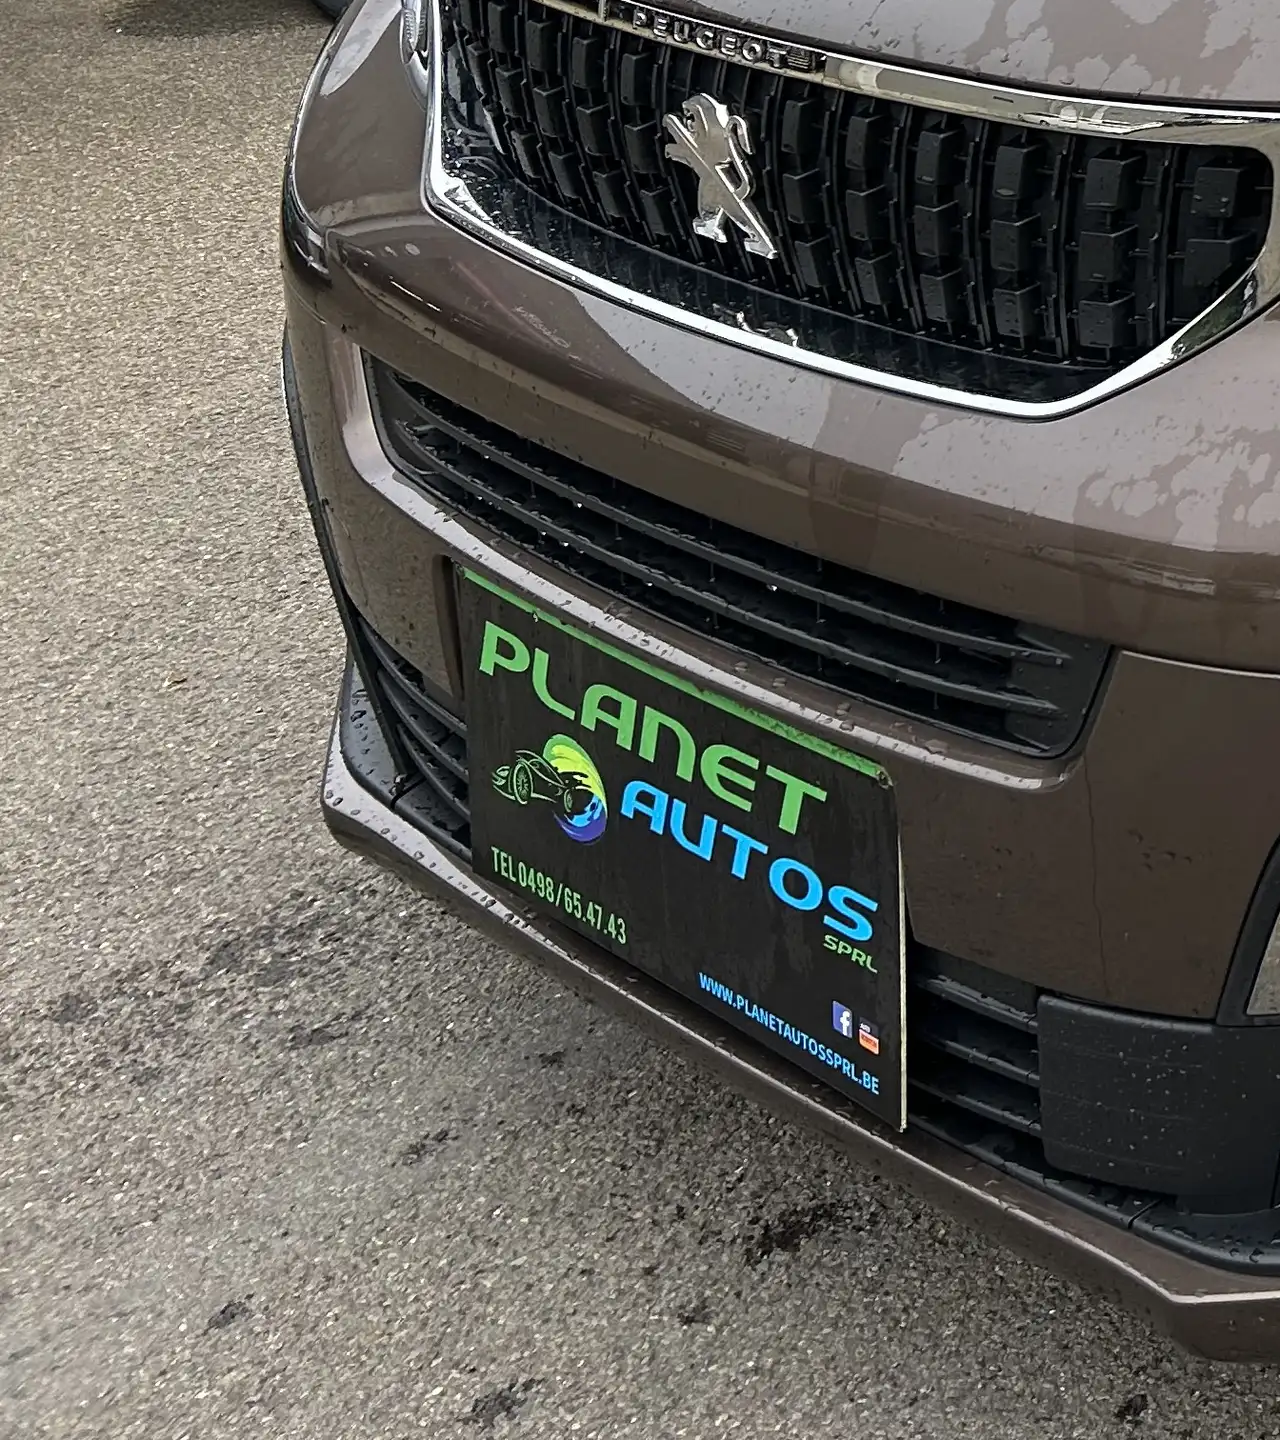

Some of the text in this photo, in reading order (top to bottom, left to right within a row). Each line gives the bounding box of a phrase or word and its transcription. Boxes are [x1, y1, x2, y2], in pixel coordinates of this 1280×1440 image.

[631, 8, 788, 69] PEUGEOT
[478, 620, 828, 836] PLANET
[491, 846, 627, 945] TEL 0498/65.47.43
[620, 780, 879, 942] AUTOS
[823, 934, 878, 974] SPRL
[699, 972, 880, 1096] WWW.PLANETAUTOSSPRL.BE
